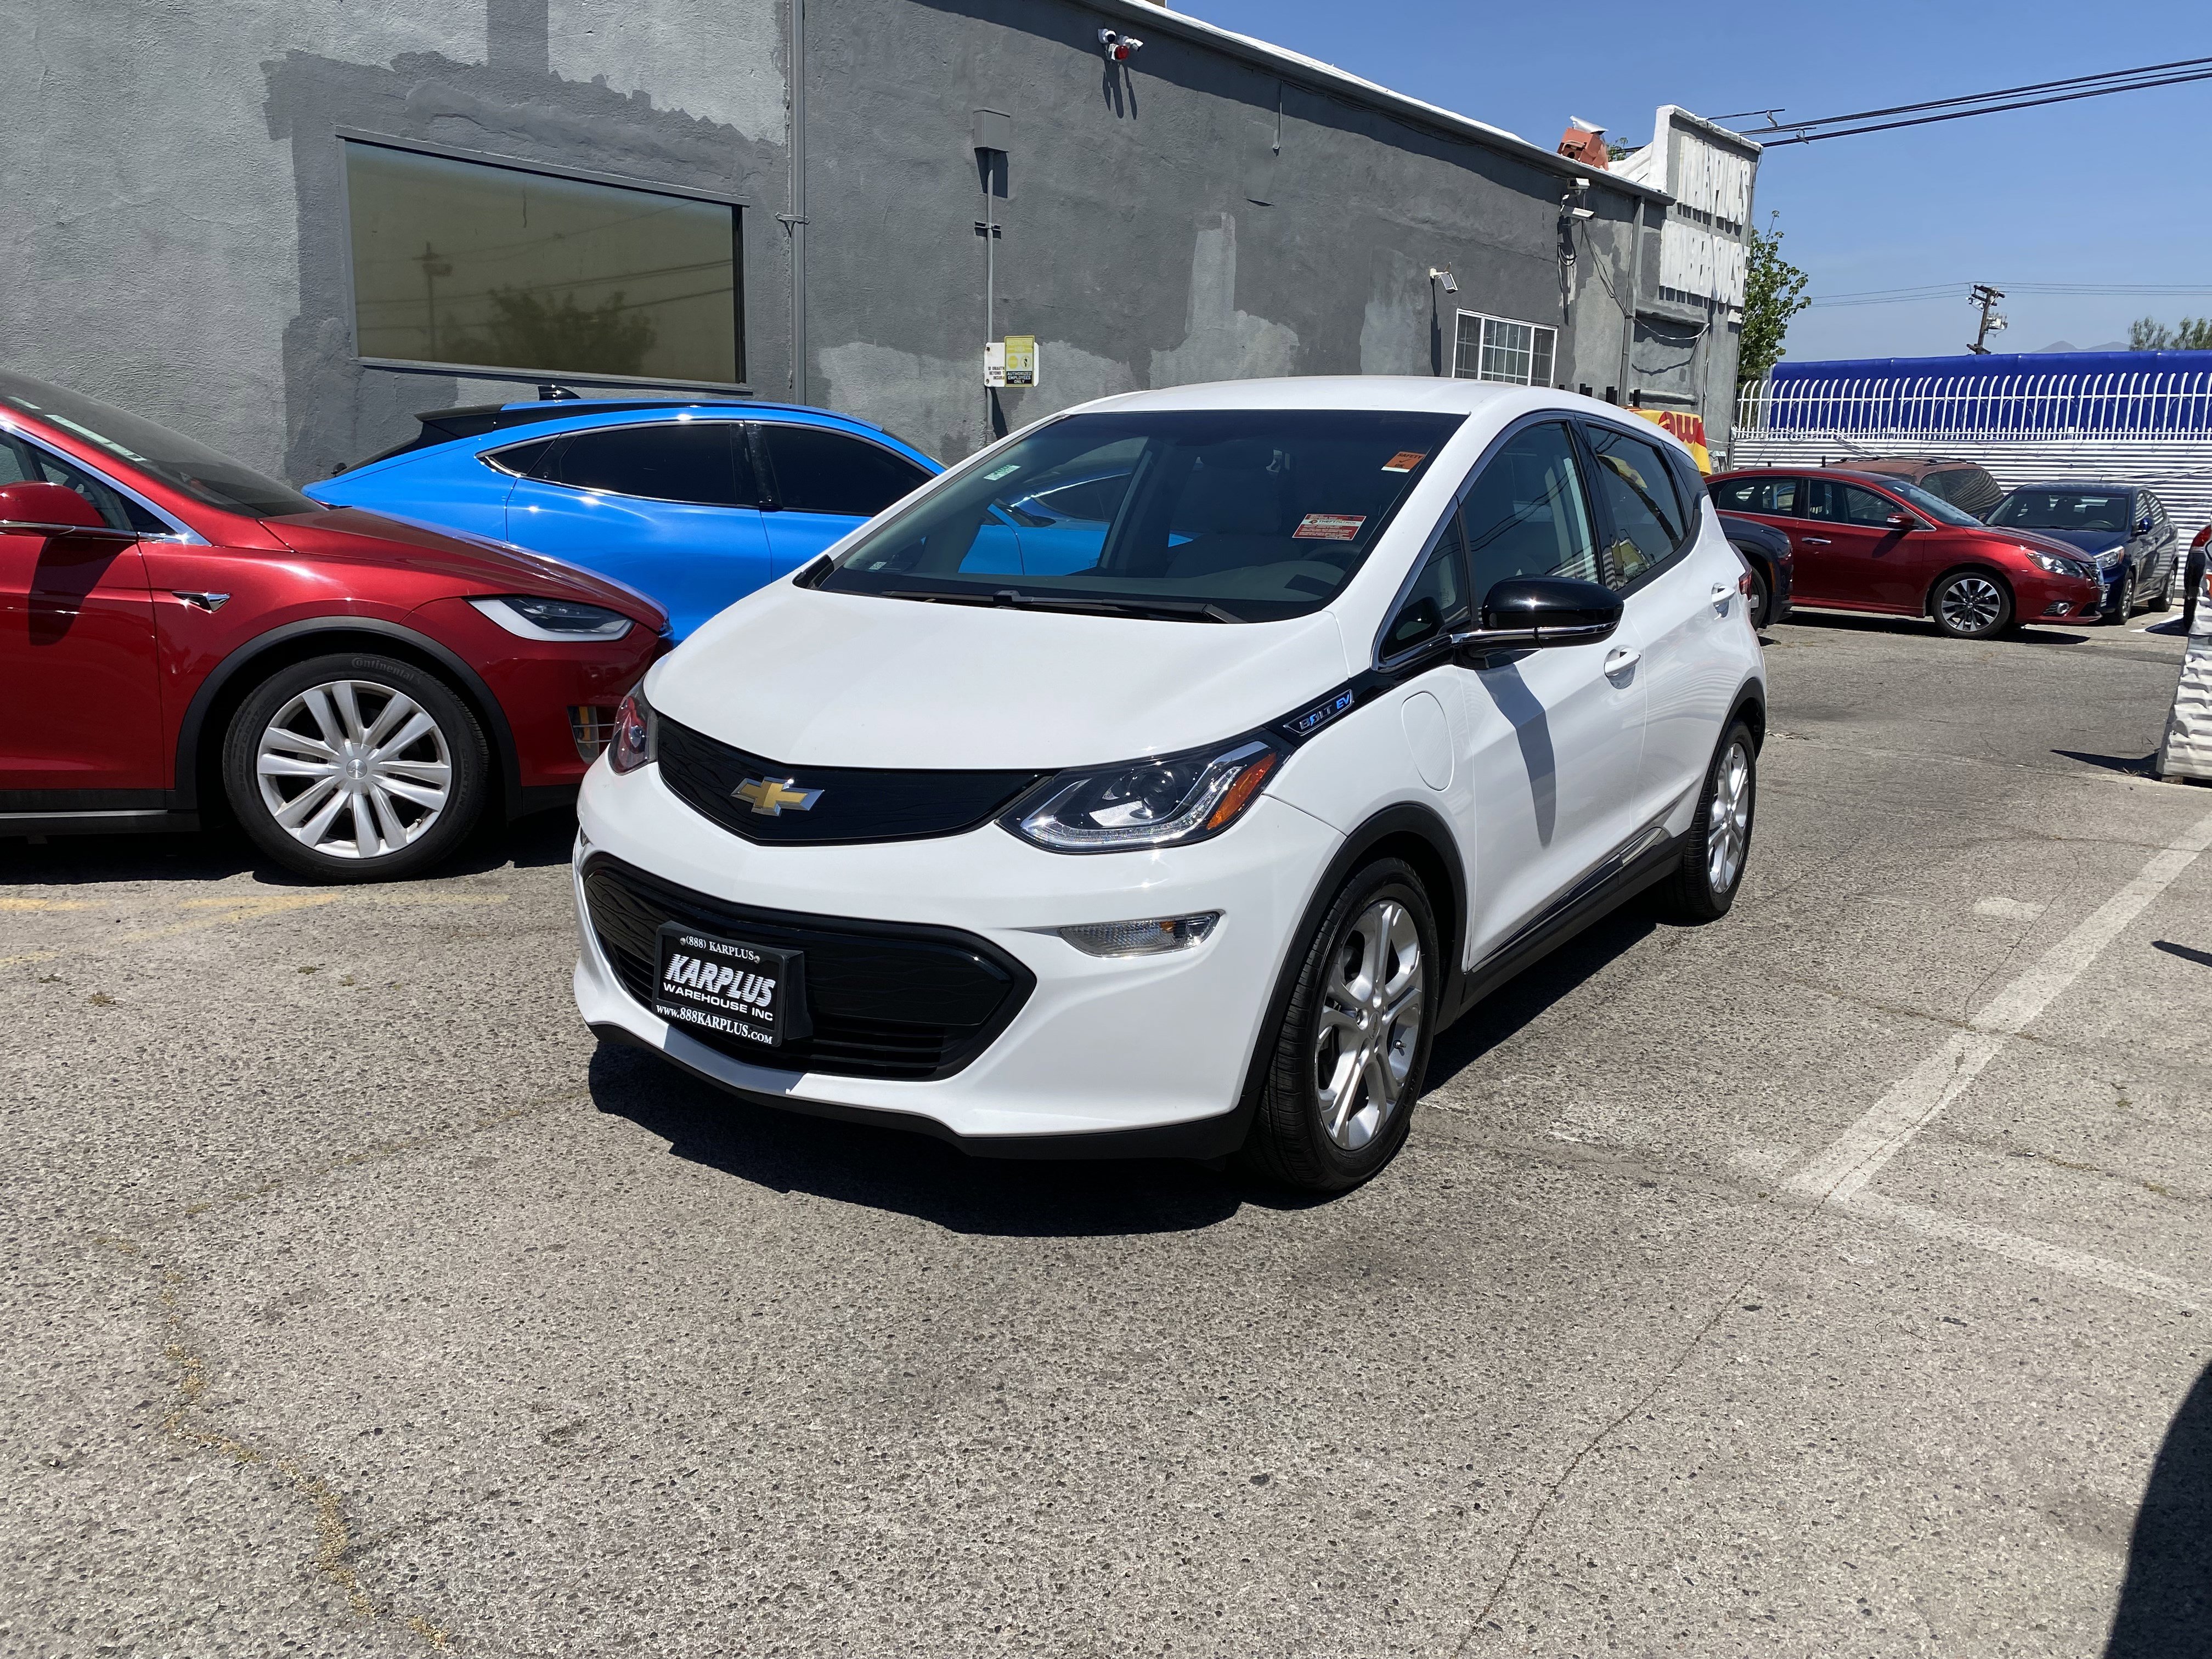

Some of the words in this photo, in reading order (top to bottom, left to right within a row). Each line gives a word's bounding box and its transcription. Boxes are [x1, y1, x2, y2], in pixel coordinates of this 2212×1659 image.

[352, 657, 415, 681] Continental
[1336, 694, 1350, 709] EV
[685, 935, 706, 949] (888)
[709, 941, 754, 961] KARPLUS
[663, 953, 776, 1007] KARPLUS
[663, 982, 748, 1013] WAREHOUSE
[752, 1007, 774, 1022] INC
